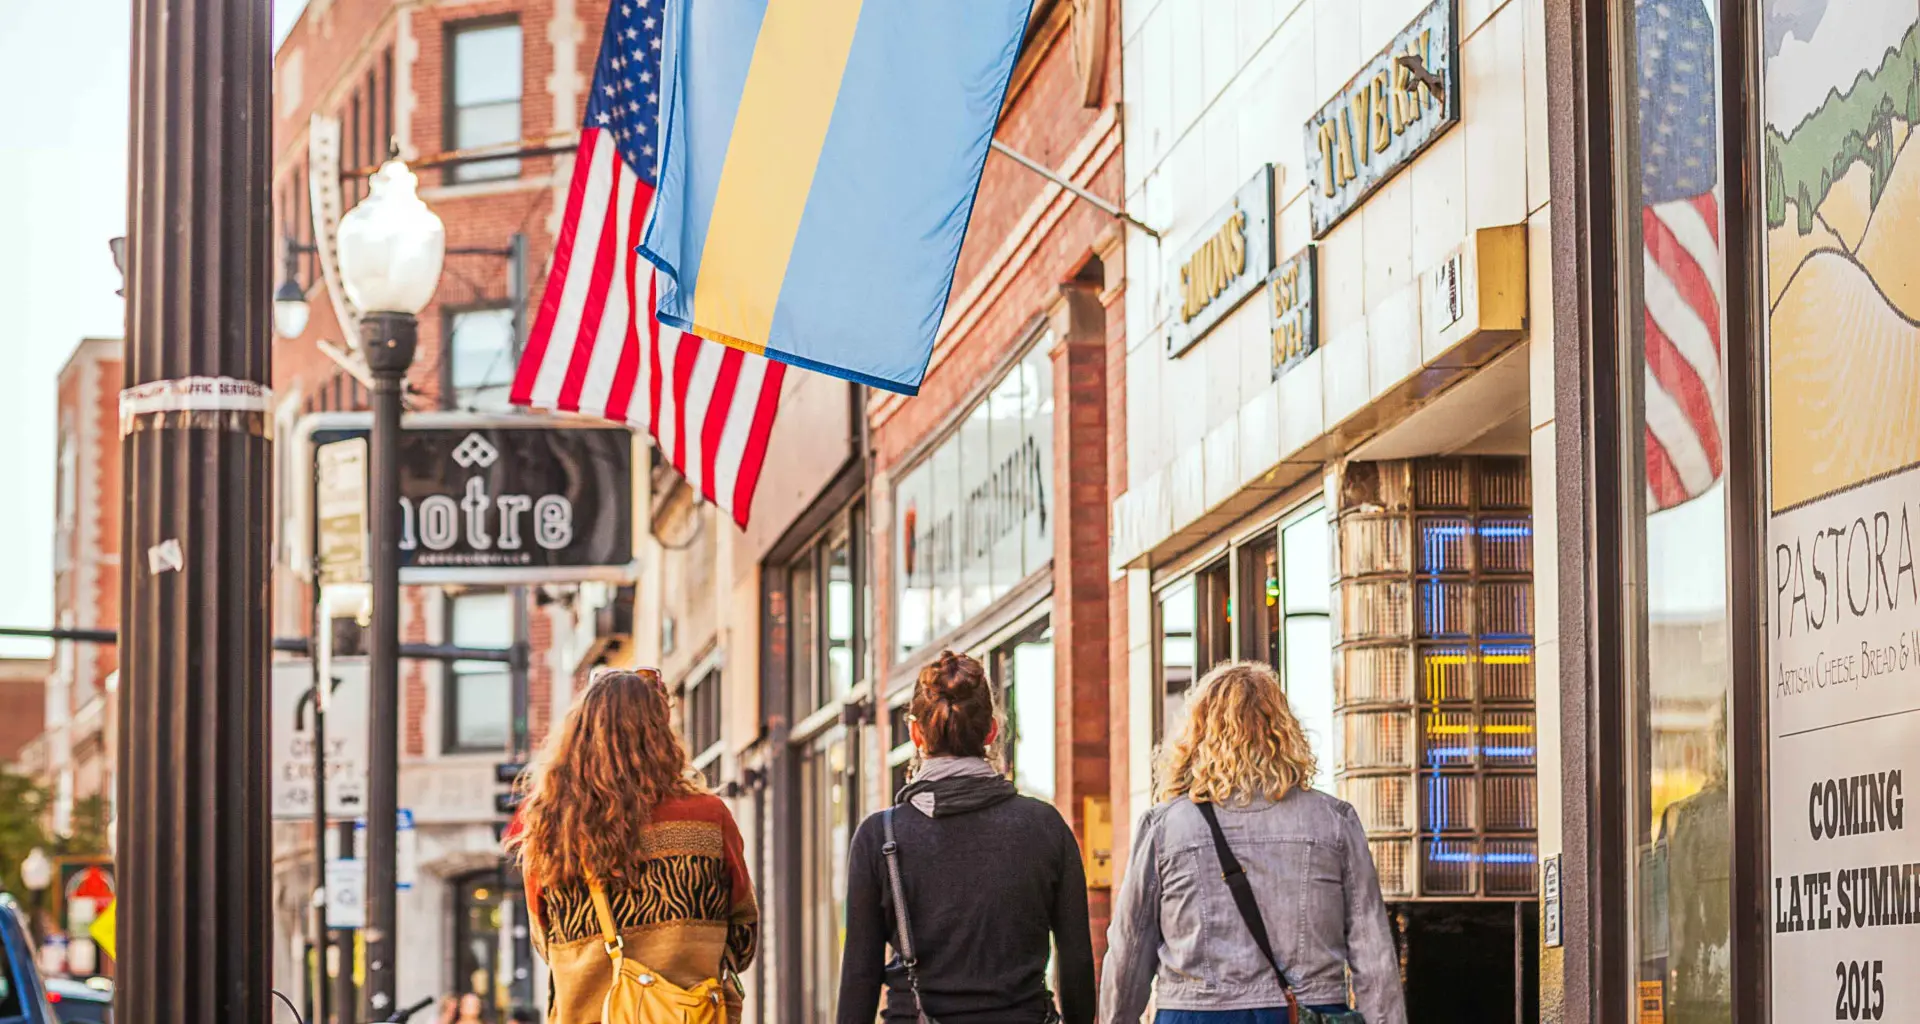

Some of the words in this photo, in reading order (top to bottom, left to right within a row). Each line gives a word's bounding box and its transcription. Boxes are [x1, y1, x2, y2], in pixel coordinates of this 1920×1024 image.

[1318, 28, 1432, 198] TAVERN
[1273, 263, 1299, 319] EST
[1776, 501, 1920, 641] PASTORA
[1777, 662, 1814, 699] ARTISAN
[1815, 651, 1860, 691] CHEESE,
[1861, 640, 1896, 680] BREAD
[1809, 769, 1904, 841] COMING
[1775, 871, 1832, 934] LATE
[1835, 959, 1885, 1021] 2015
